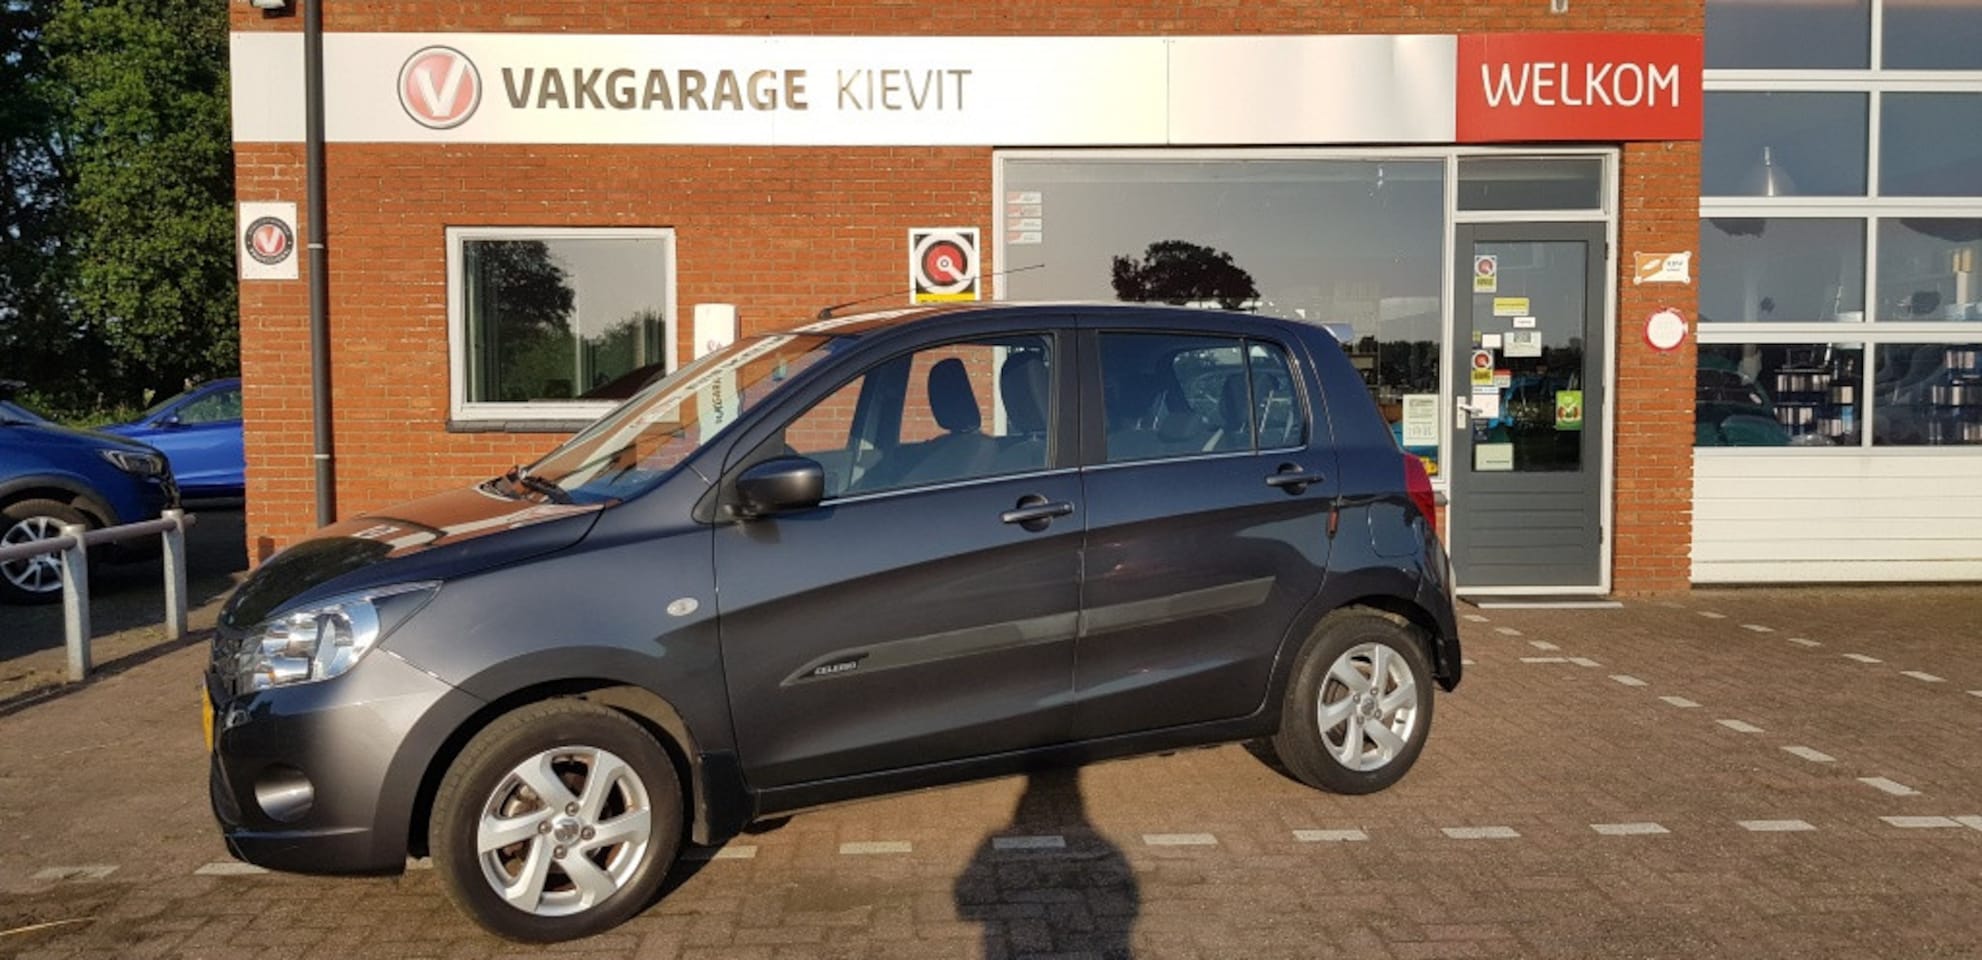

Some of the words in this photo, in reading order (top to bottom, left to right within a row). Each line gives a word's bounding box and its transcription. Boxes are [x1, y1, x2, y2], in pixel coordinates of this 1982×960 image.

[501, 67, 809, 111] VAKGARAGE
[836, 68, 973, 111] KIEVIT
[1481, 62, 1680, 108] WELKOM
